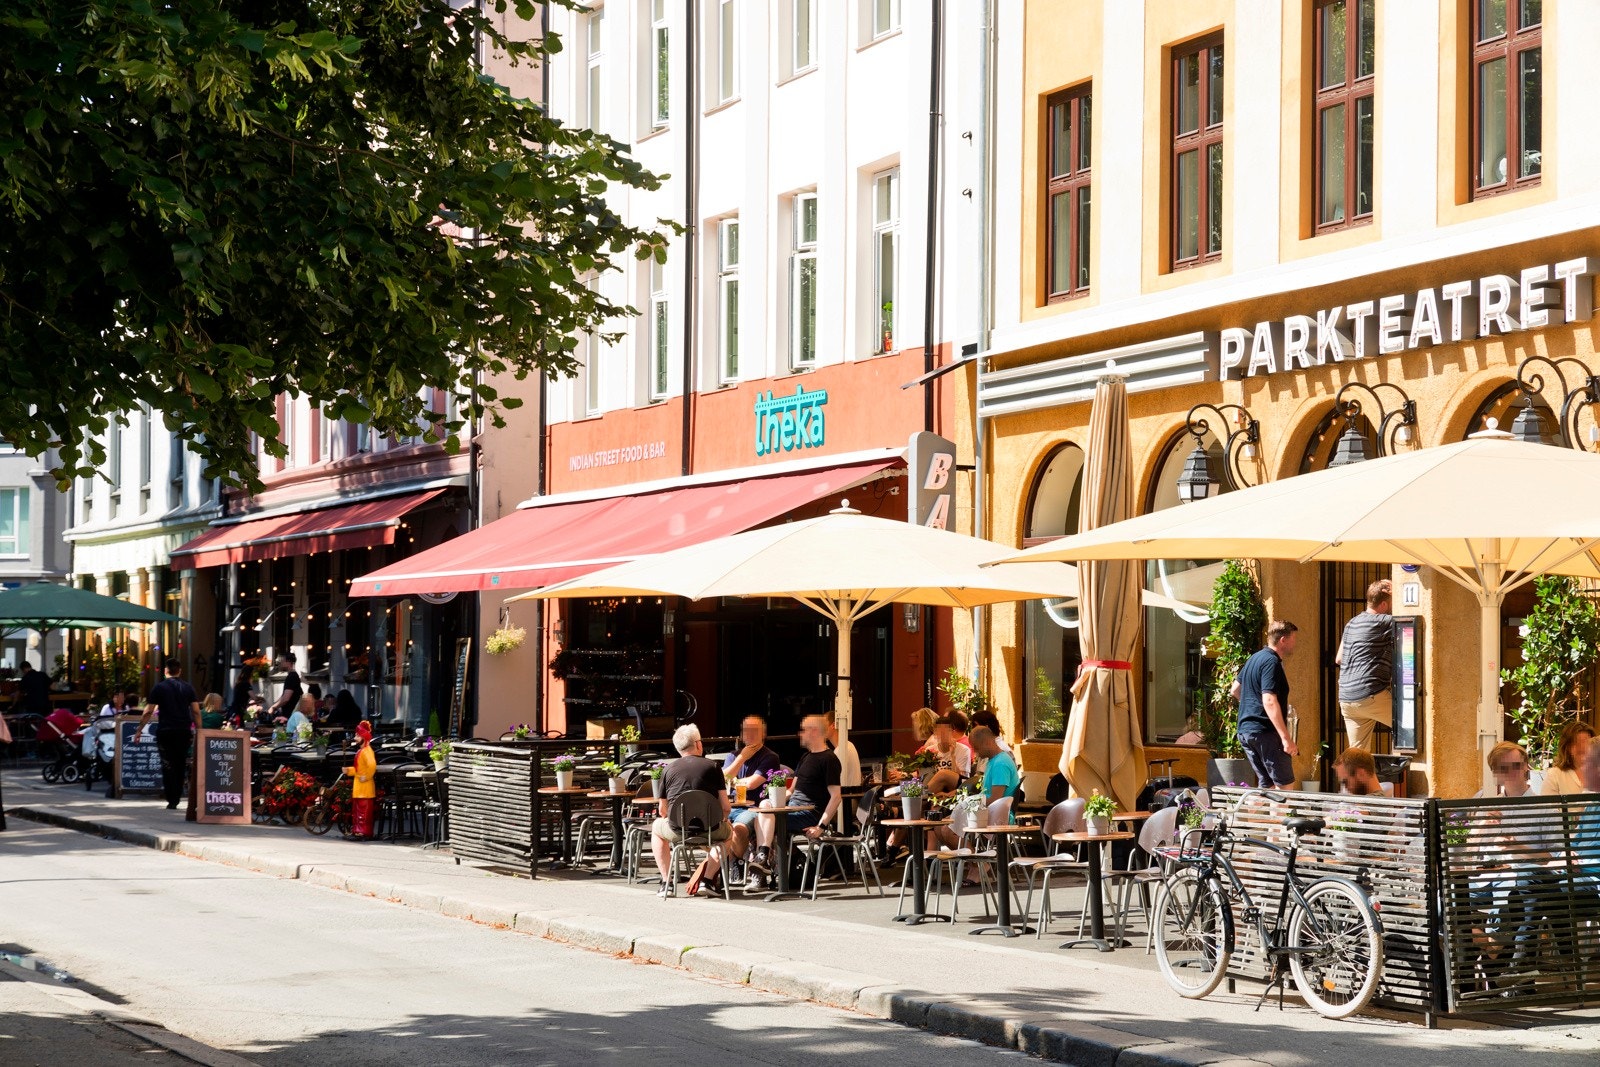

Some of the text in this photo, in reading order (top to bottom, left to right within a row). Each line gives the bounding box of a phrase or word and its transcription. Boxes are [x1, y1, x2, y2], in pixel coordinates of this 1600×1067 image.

[1219, 256, 1590, 382] PARKTEATRET
[754, 384, 828, 457] theka
[569, 441, 665, 471] INDIAN STREET FOOD & BAR
[1405, 586, 1414, 603] 11
[210, 740, 238, 749] DAGENS
[206, 791, 241, 804] theka
